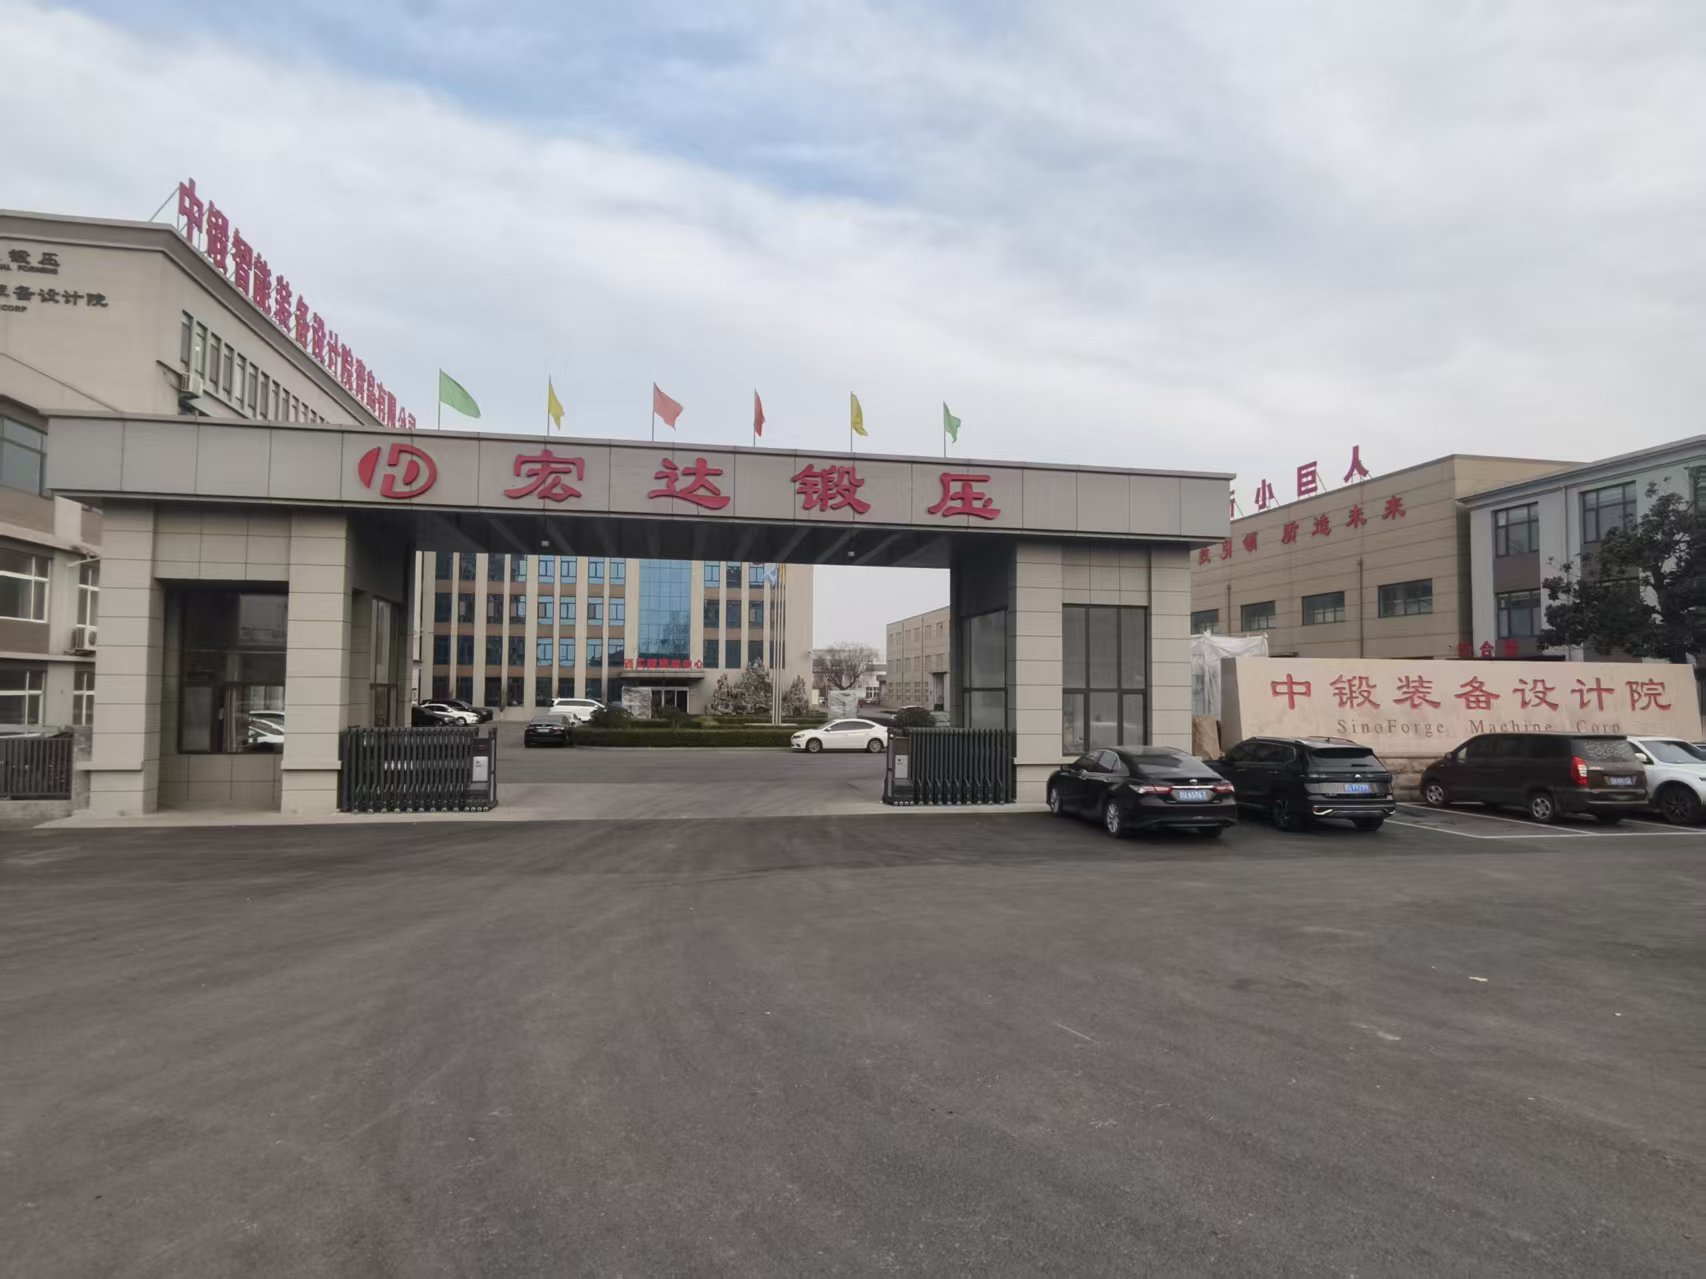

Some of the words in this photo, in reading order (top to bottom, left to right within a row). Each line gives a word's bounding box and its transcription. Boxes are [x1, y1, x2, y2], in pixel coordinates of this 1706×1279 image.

[503, 448, 1001, 520] 宏达锻压
[1230, 444, 1369, 518] 小巨人
[1270, 672, 1673, 712] 中锻装备设计院
[1336, 718, 1447, 736] SinoForge
[1468, 718, 1554, 734] Machine
